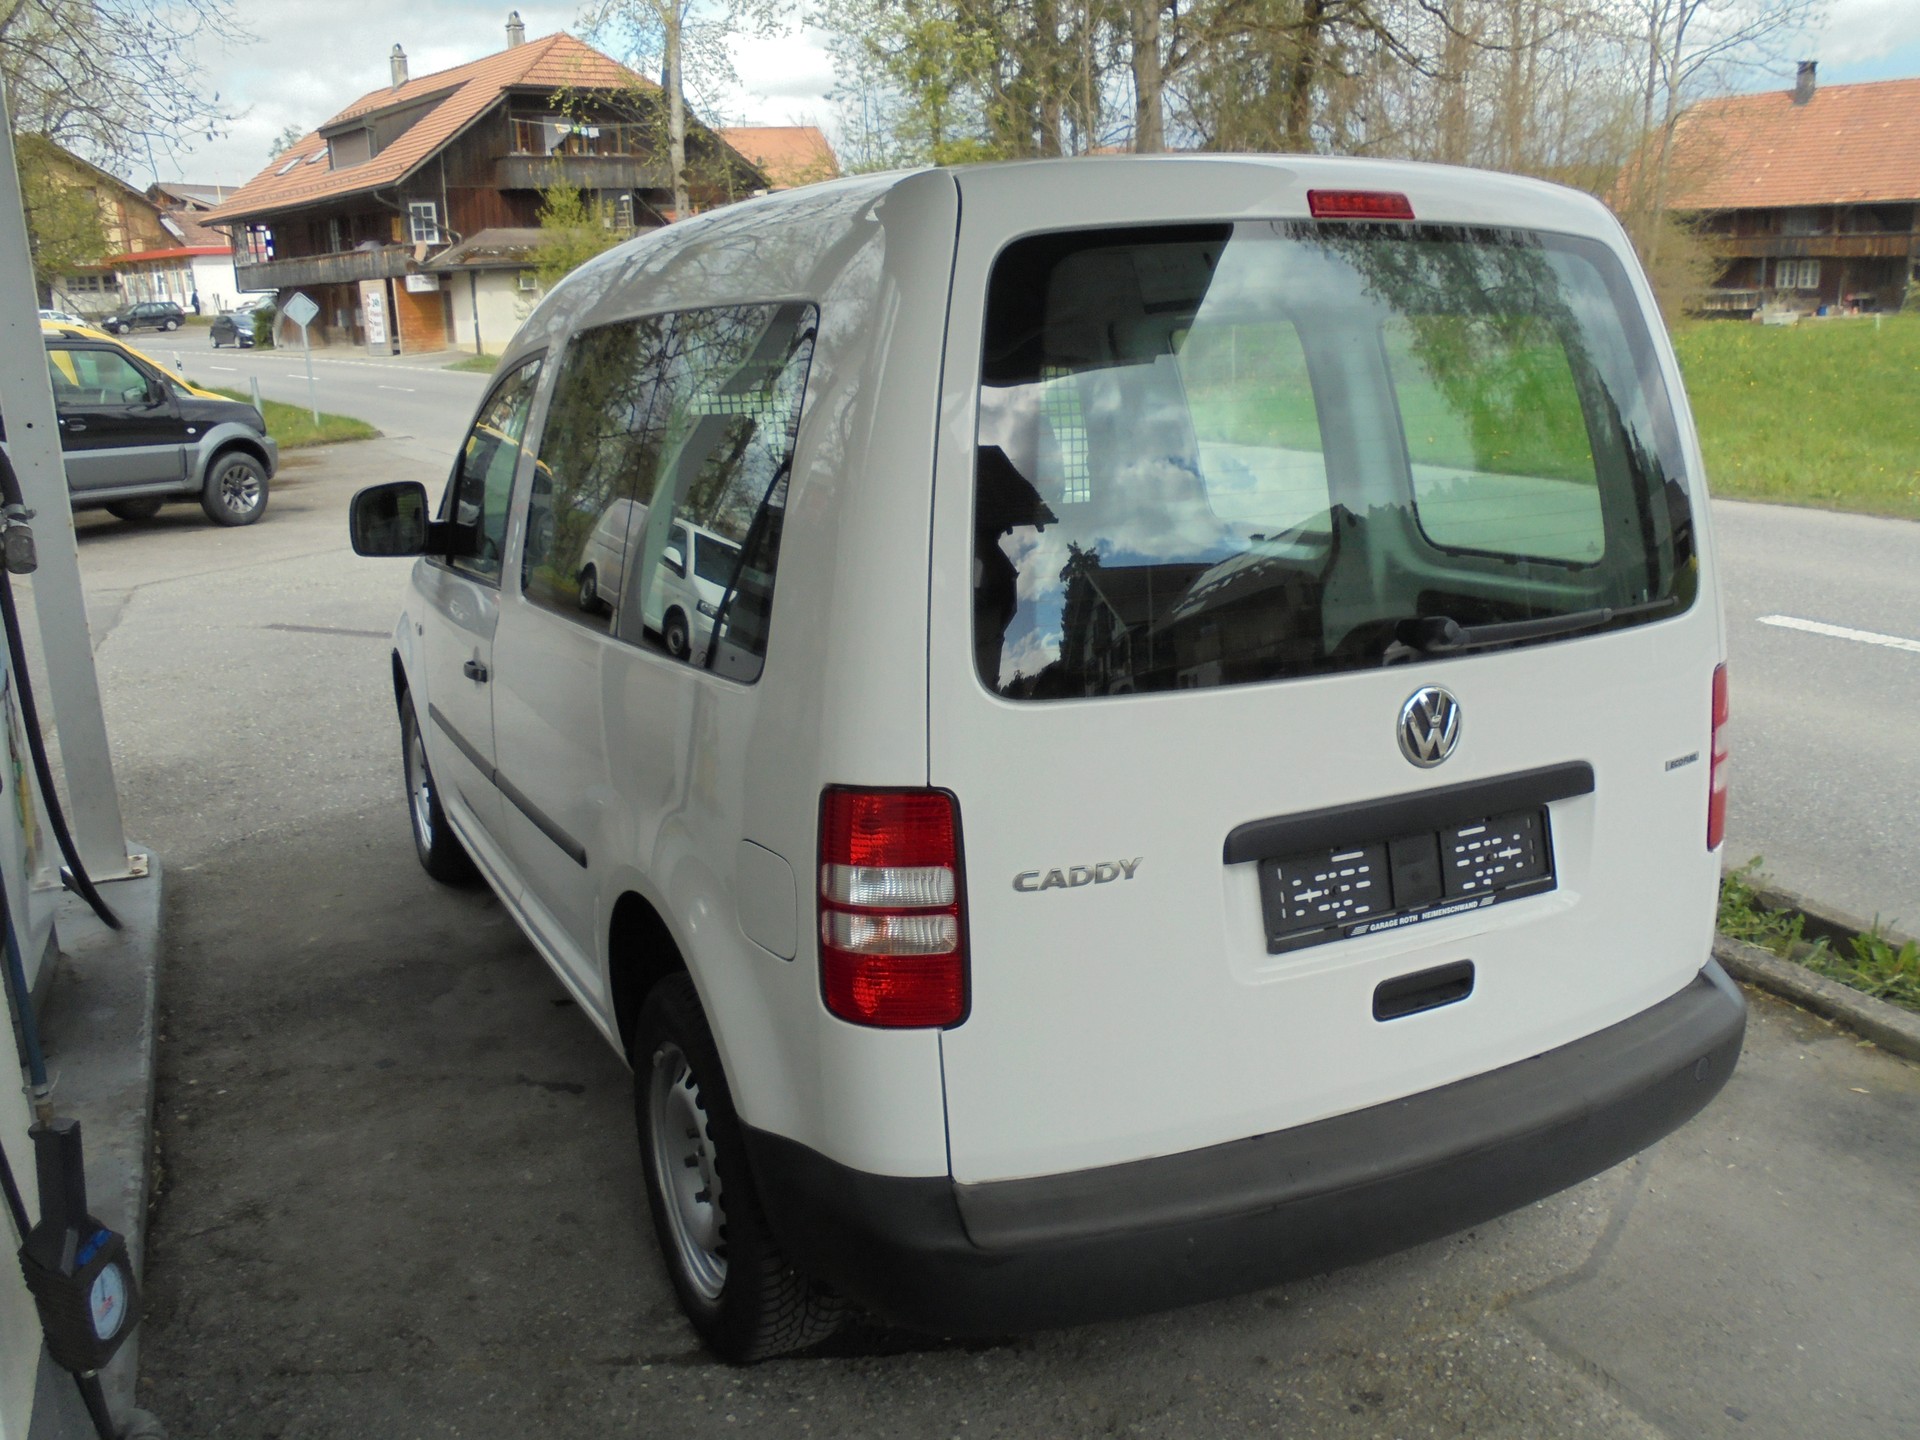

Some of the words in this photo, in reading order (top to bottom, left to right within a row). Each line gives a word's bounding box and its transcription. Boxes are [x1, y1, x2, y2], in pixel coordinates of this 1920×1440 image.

[1012, 857, 1143, 892] CADDY
[1369, 919, 1398, 931] GARAGE
[1399, 915, 1418, 925] ROTH
